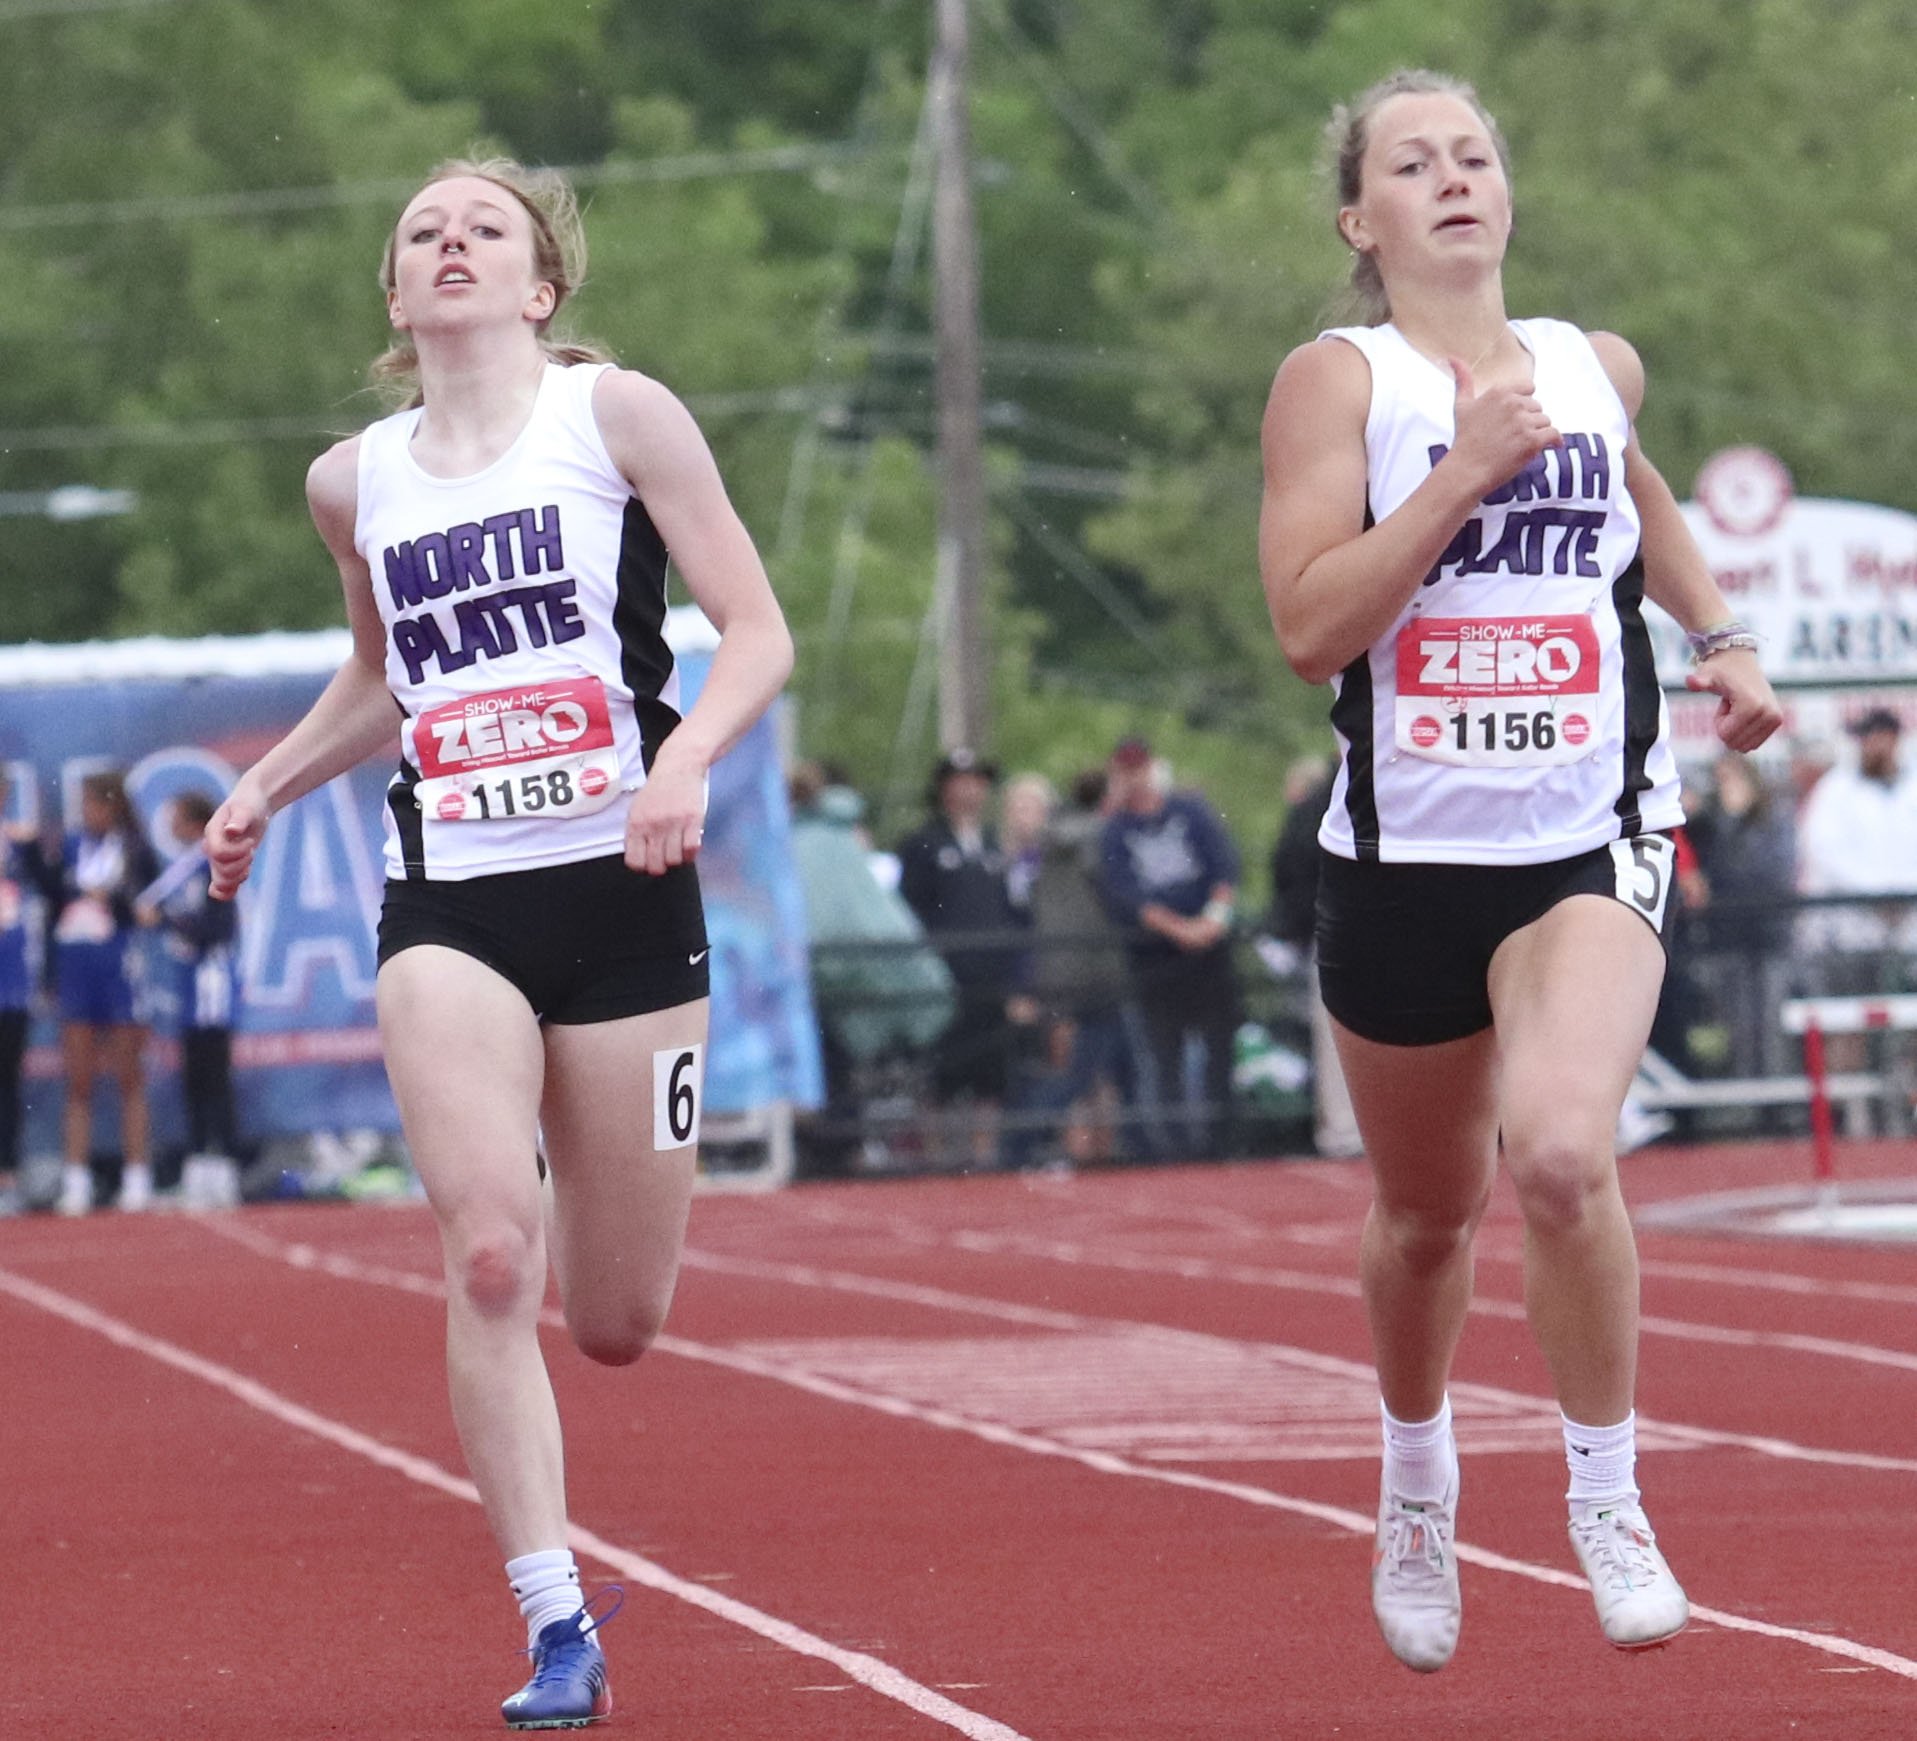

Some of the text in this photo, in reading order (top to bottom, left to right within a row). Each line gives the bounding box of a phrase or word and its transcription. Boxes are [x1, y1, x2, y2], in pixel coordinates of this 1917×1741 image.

[1428, 433, 1610, 505] RTH
[383, 504, 564, 611] NORTH
[1423, 507, 1607, 586] PLATTE
[393, 579, 585, 685] PLATTE
[1418, 637, 1581, 684] ZERO
[1459, 623, 1546, 641] SHOW-ME
[431, 701, 588, 765] ZERO
[464, 692, 545, 717] SHOW-ME
[1450, 710, 1556, 752] 1156
[472, 769, 574, 820] 1158
[1631, 838, 1663, 912] 5
[668, 1051, 694, 1142] 6
